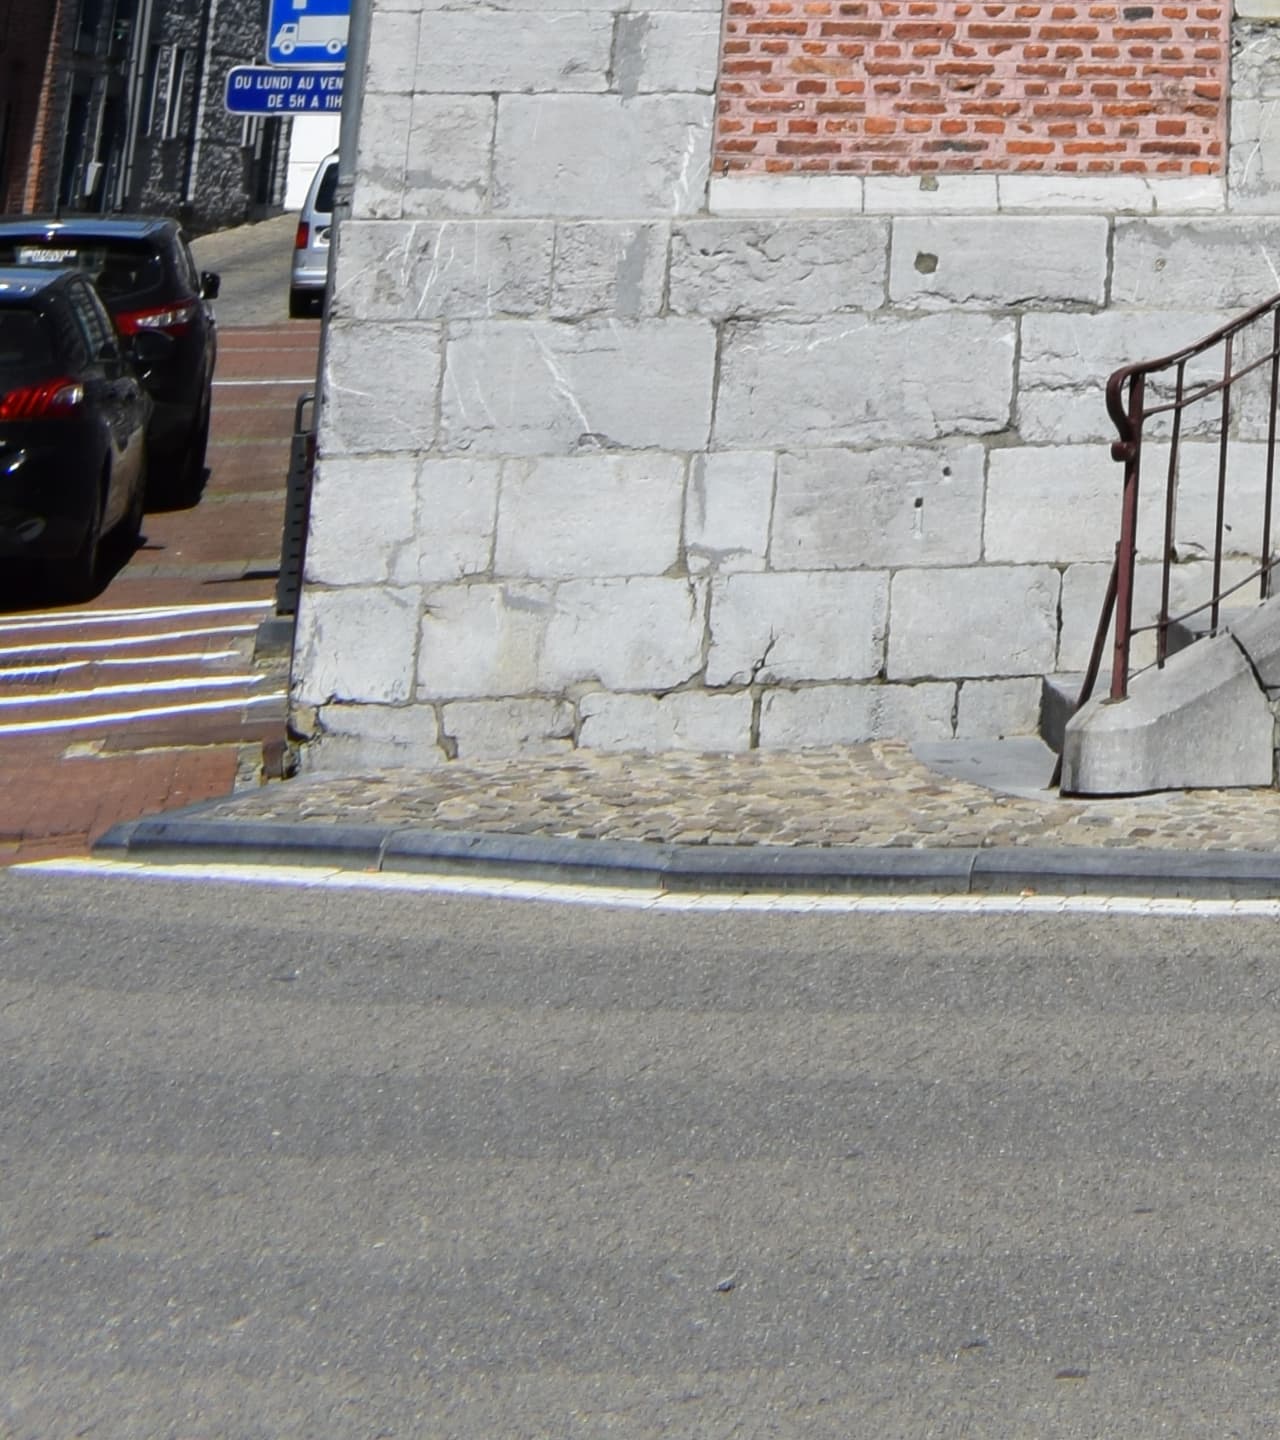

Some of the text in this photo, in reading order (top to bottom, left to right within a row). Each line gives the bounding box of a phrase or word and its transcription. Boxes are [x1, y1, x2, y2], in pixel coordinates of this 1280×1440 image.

[234, 76, 344, 90] DU LUNDI AU VEN
[267, 94, 283, 108] DE
[289, 95, 305, 108] 5H
[310, 95, 319, 108] A
